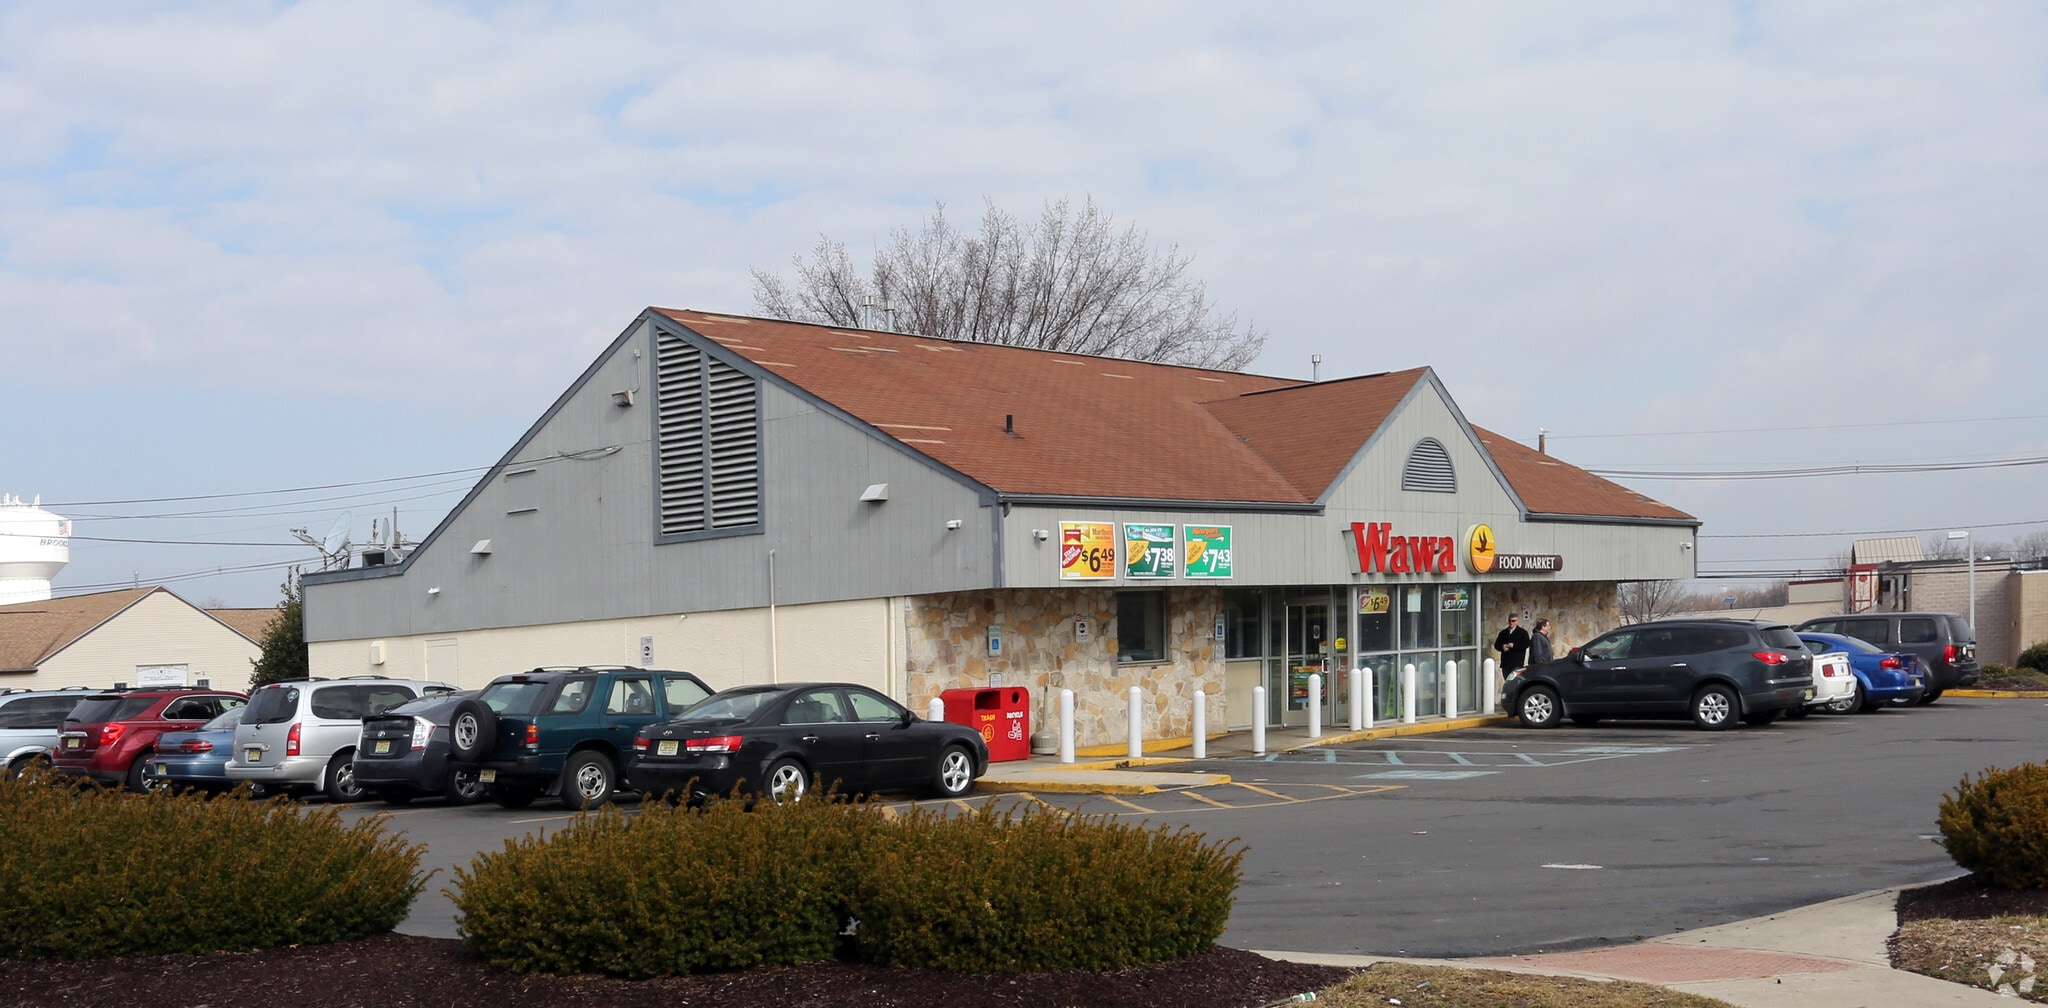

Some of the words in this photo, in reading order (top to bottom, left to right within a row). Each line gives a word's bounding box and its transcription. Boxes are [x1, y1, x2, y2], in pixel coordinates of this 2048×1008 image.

[1351, 522, 1456, 573] Wawa
[1499, 556, 1522, 569] FOOD
[1524, 556, 1555, 570] MARKET
